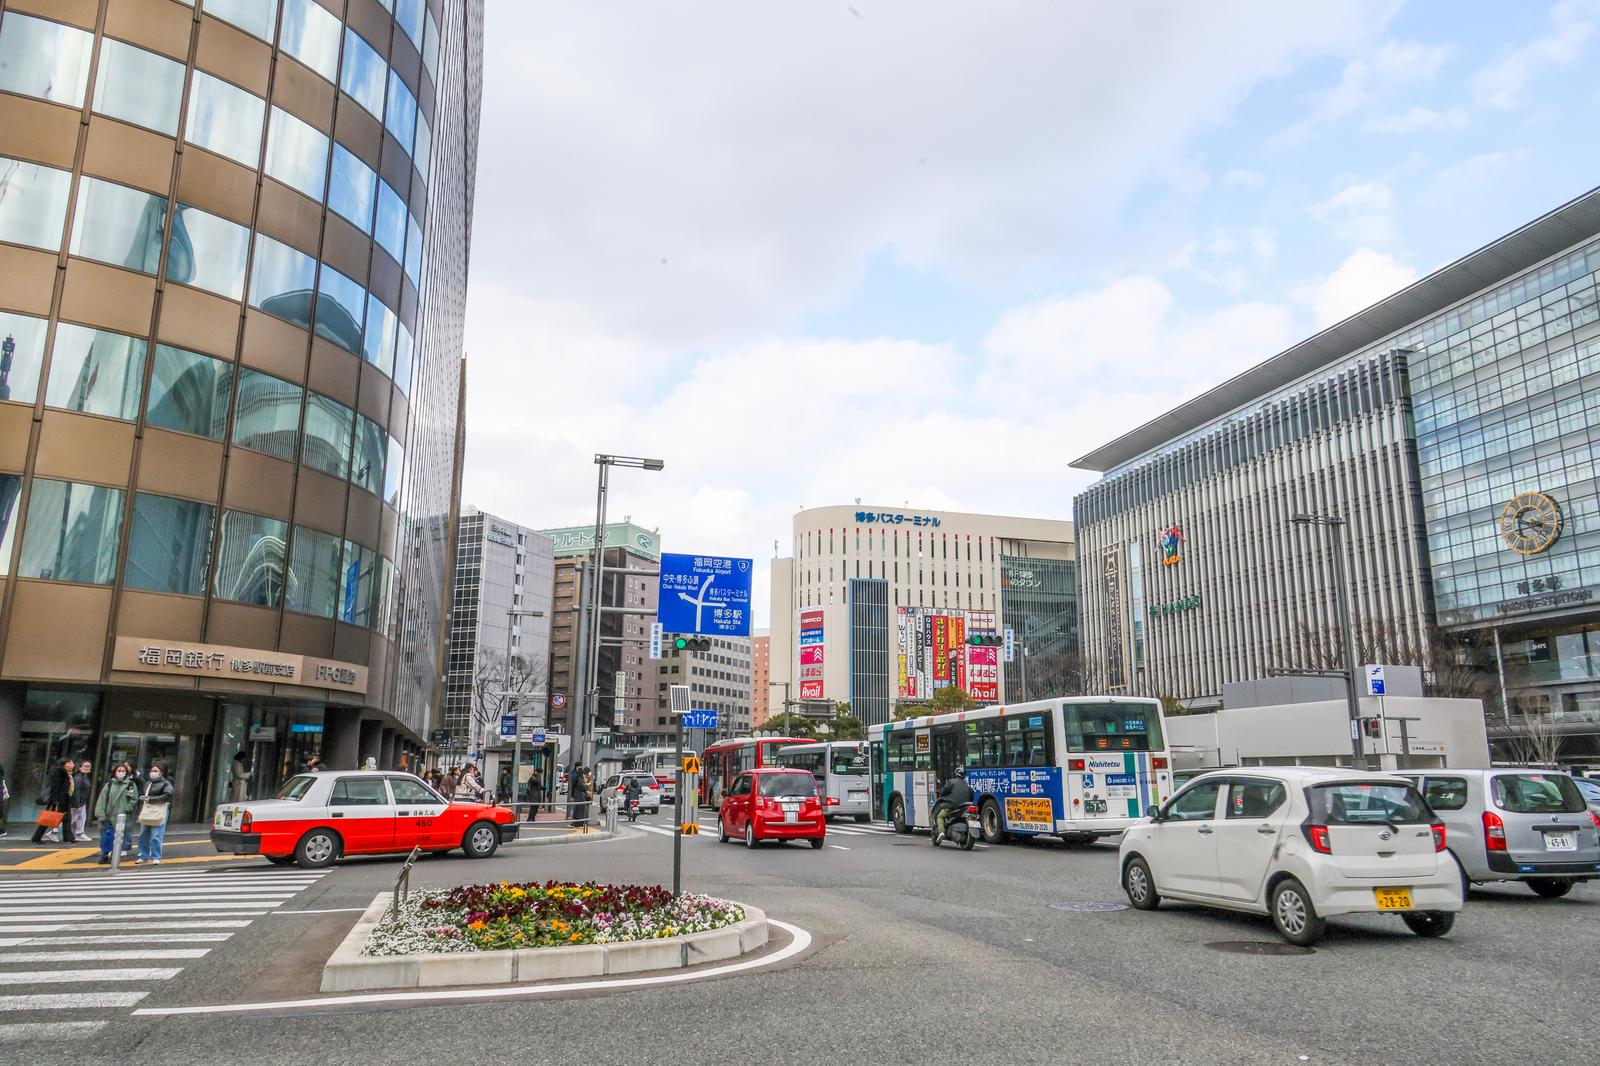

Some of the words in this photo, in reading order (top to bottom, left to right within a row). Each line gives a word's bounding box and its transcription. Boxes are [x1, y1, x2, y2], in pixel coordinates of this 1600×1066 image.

[855, 511, 941, 527] 博多バスターミナル
[693, 557, 732, 569] 福岡空港
[1163, 554, 1181, 566] PLAZA
[1516, 576, 1564, 596] 博多駅
[709, 588, 748, 597] 博多バスターミナル
[1162, 595, 1200, 614] HANDS
[713, 608, 742, 619] 博多駅
[138, 645, 225, 670] 福岡銀行
[230, 658, 295, 678] 博多駅前支店
[801, 667, 822, 677] しまむら
[970, 669, 997, 678] しまむら
[801, 686, 821, 698] Avail
[970, 687, 996, 698] Avail
[1088, 760, 1121, 769] Nishitetsu
[970, 778, 1010, 793] 長崎国際大学
[416, 818, 432, 827] 460
[1551, 838, 1570, 847] 65-81
[1383, 896, 1410, 907] 28-20
